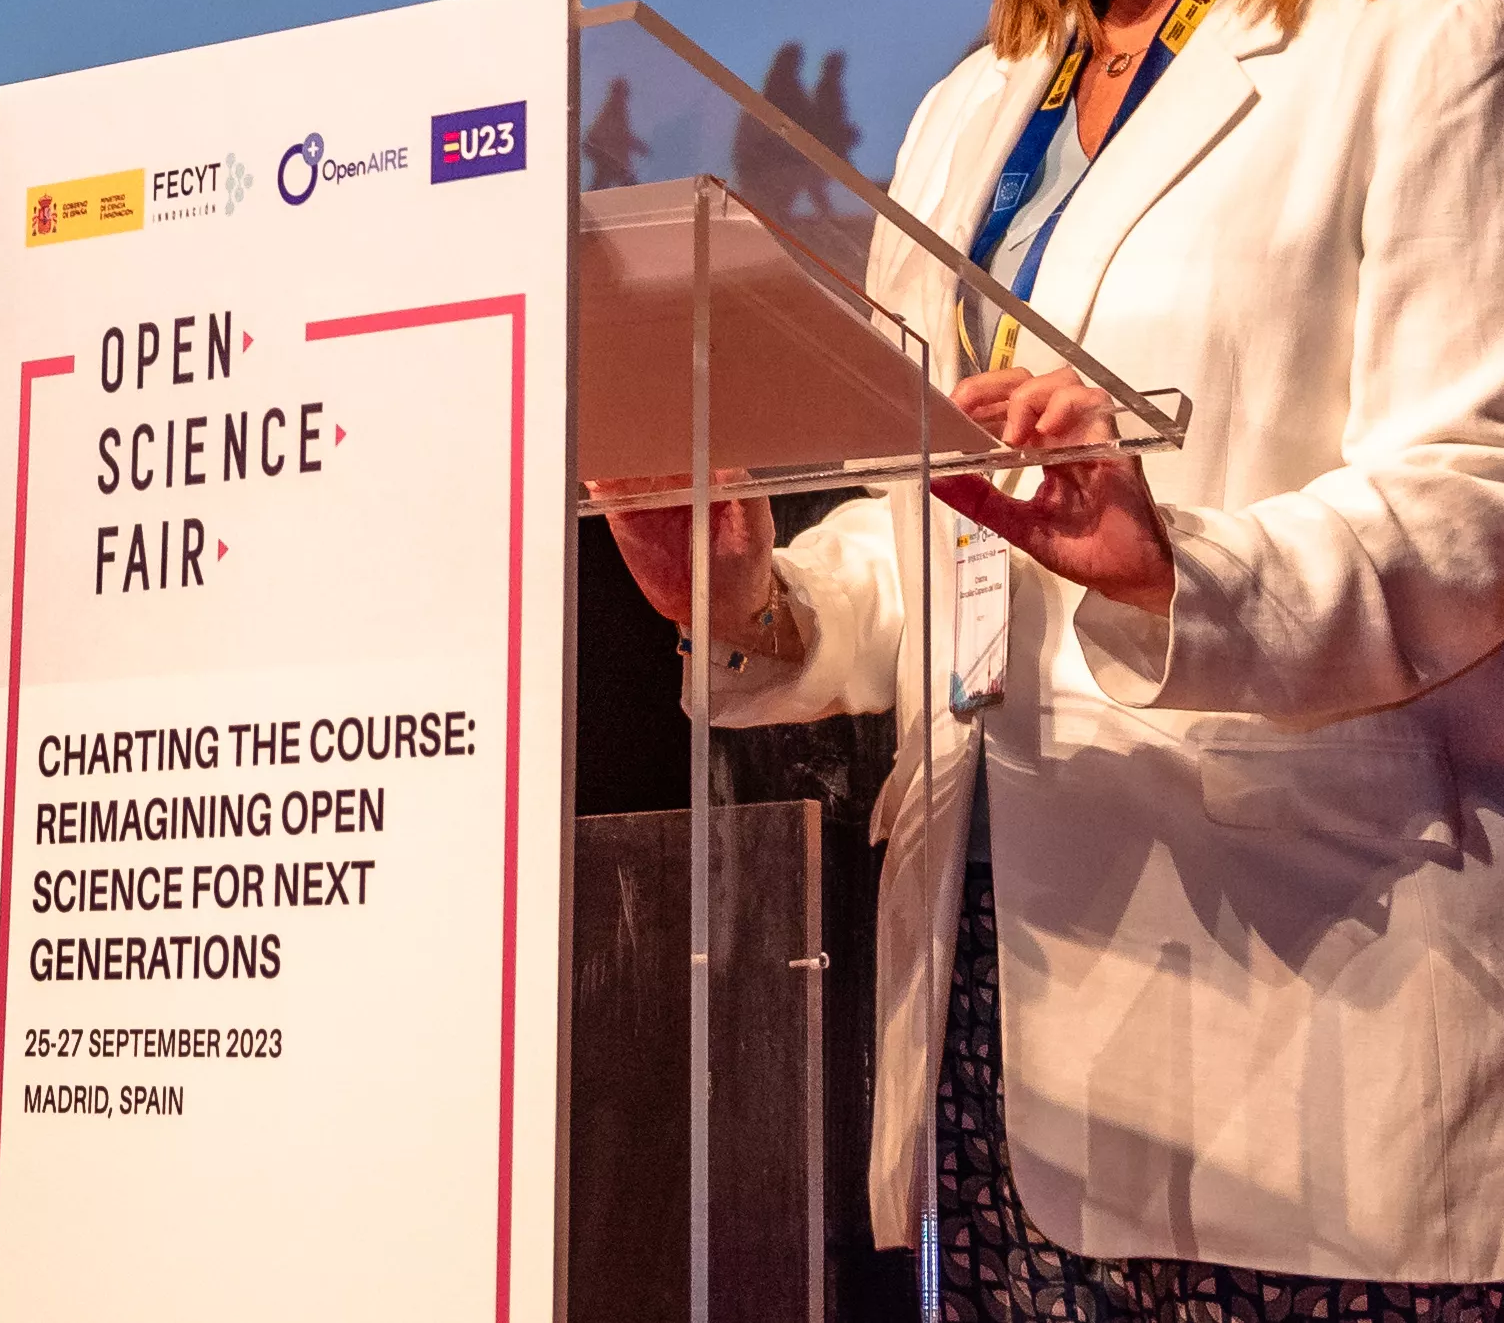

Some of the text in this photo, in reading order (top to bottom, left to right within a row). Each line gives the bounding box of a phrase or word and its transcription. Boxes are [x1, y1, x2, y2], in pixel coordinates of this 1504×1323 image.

[153, 162, 221, 201] FECYT
[321, 147, 408, 185] OpenAIRE
[101, 310, 232, 394] OPEN
[97, 402, 323, 495] SCIENCE
[95, 517, 205, 595] FAIR
[38, 711, 476, 778] CHARTING THE COURSE:
[36, 787, 385, 845] REIMAGINING OPEN
[32, 860, 376, 914] SCIENCE FOR NEXT
[29, 933, 281, 982] GENERATIONS
[24, 1028, 283, 1059] 25-27 SEPTEMBER 2023
[24, 1084, 184, 1119] MADRID, SPAIN
